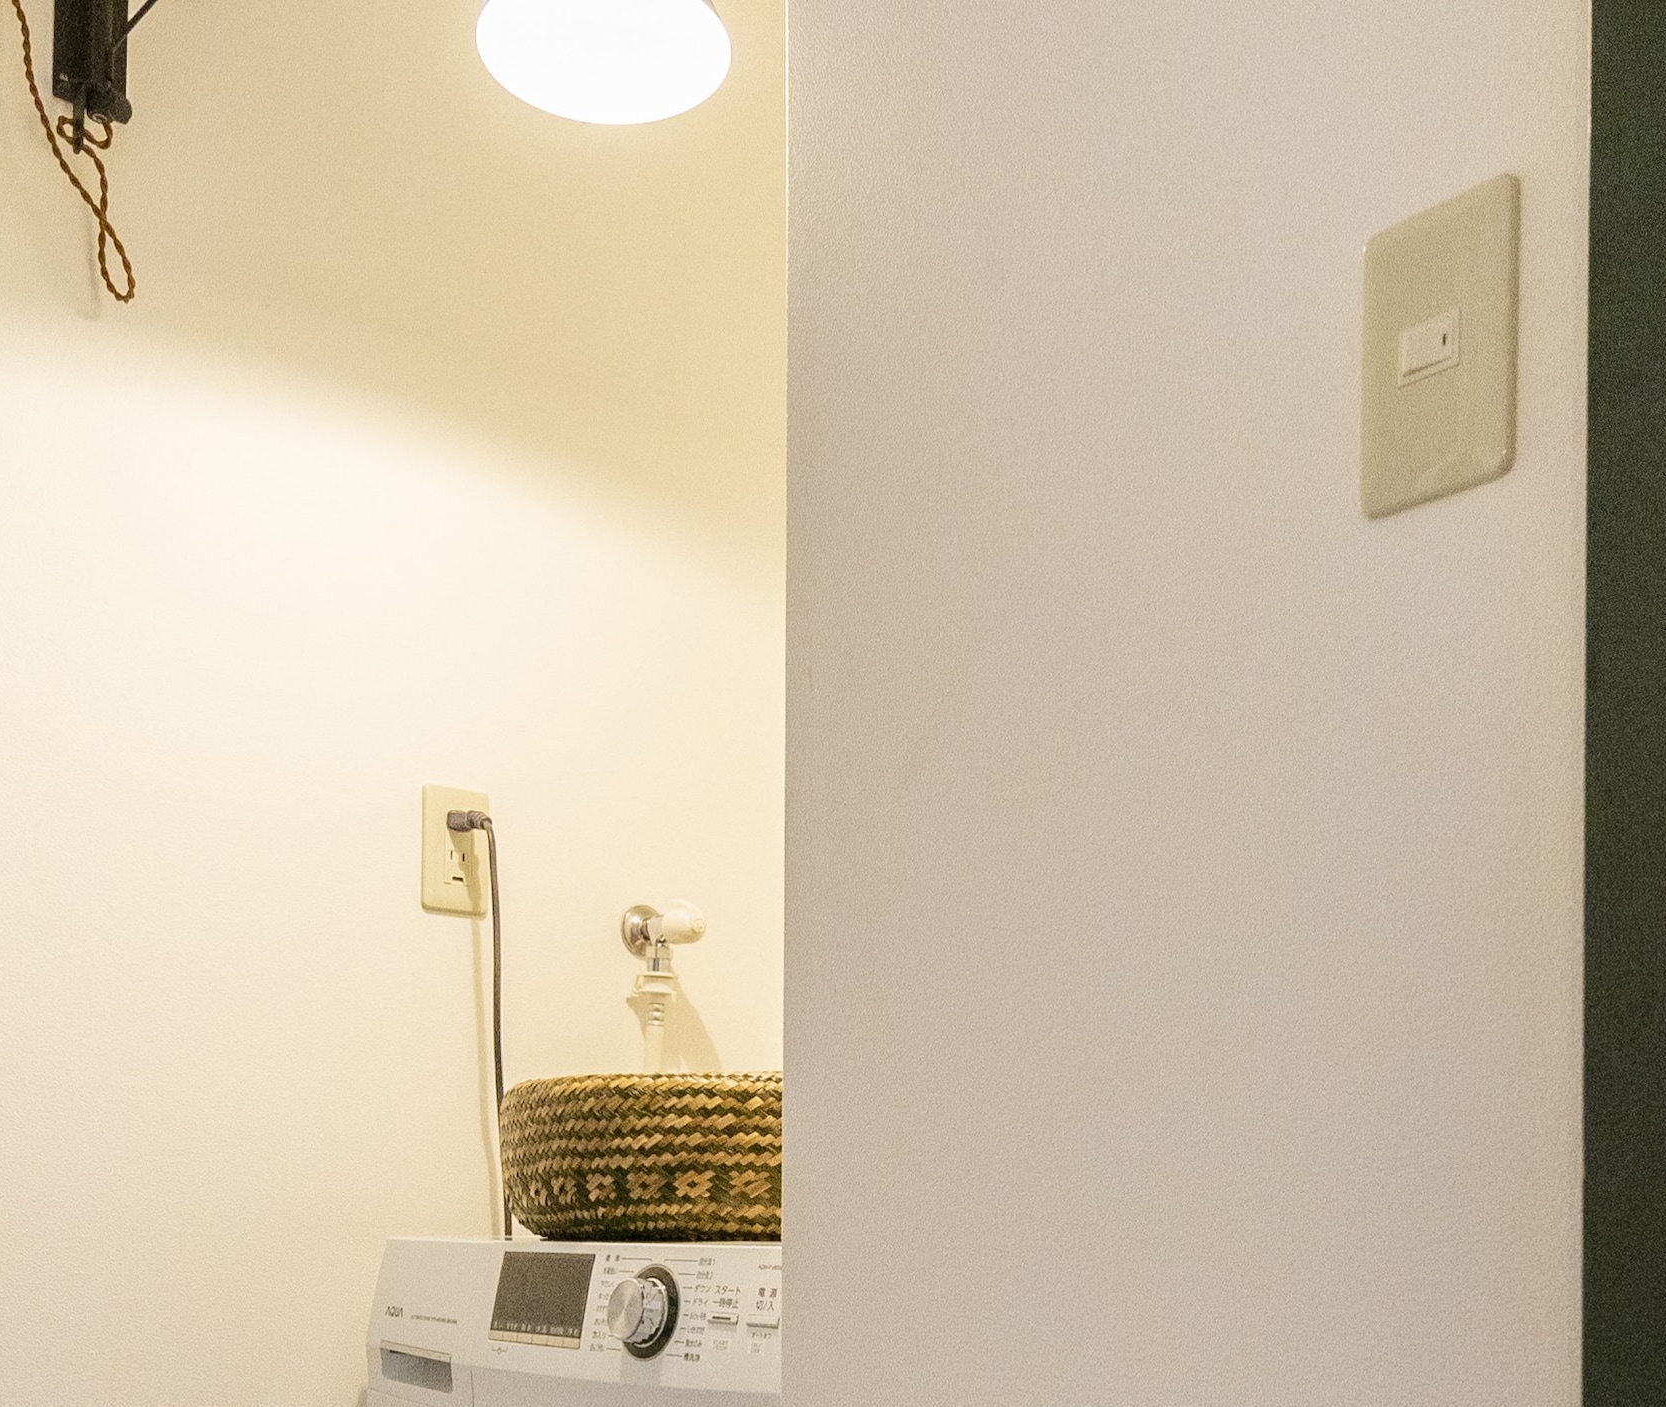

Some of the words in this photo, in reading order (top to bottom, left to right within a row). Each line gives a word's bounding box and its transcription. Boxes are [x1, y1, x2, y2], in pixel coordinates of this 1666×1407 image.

[714, 1285, 742, 1296] スタート
[712, 1299, 739, 1309] 一時停止
[385, 1306, 404, 1318] AQUA
